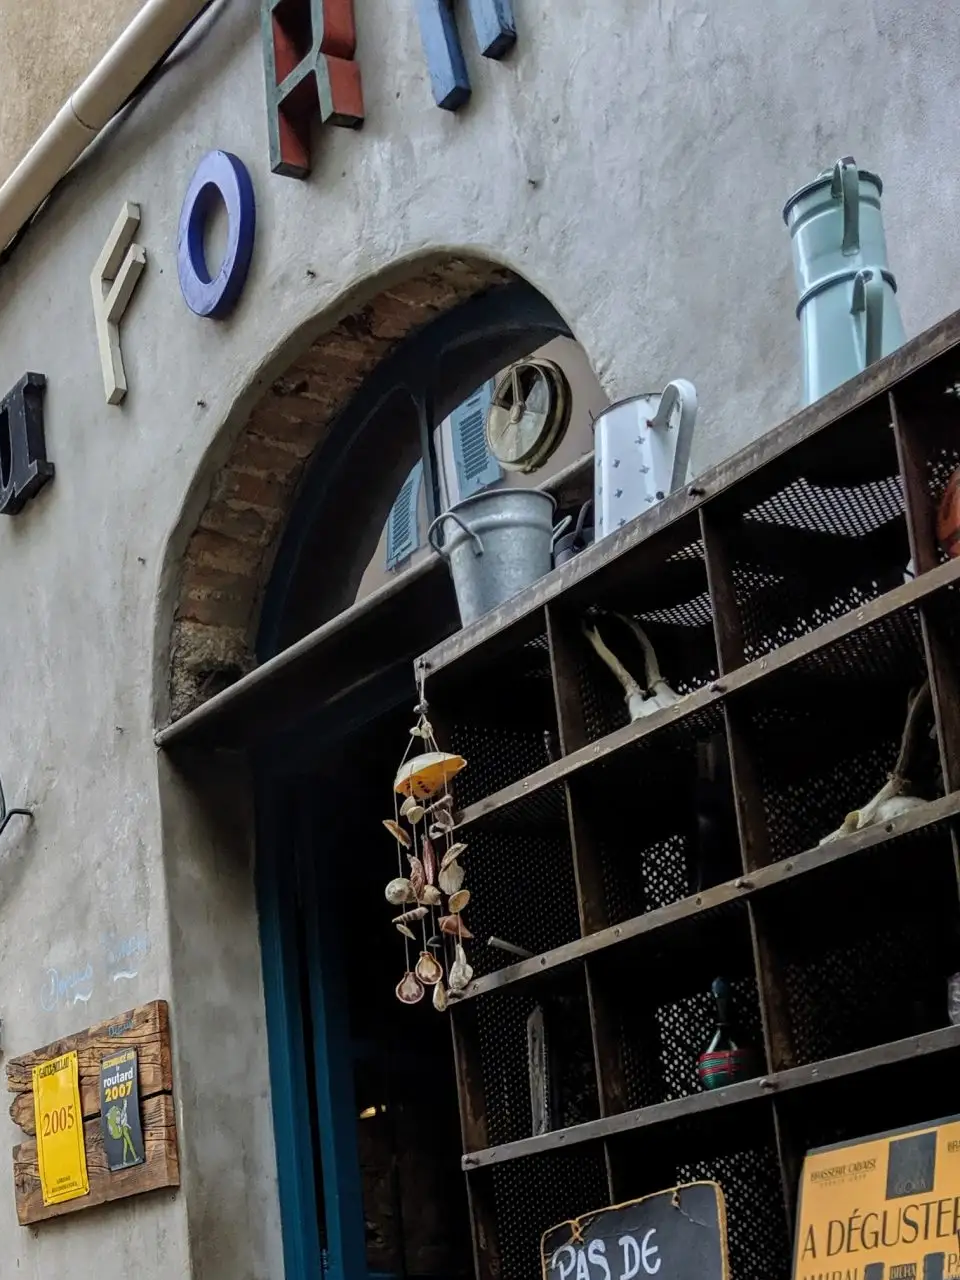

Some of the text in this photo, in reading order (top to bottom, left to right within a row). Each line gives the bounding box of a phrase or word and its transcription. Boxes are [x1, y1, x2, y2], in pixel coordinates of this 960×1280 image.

[103, 1067, 134, 1088] routard
[104, 1080, 133, 1103] 2007
[43, 1104, 75, 1137] 2005
[801, 1223, 817, 1262] A
